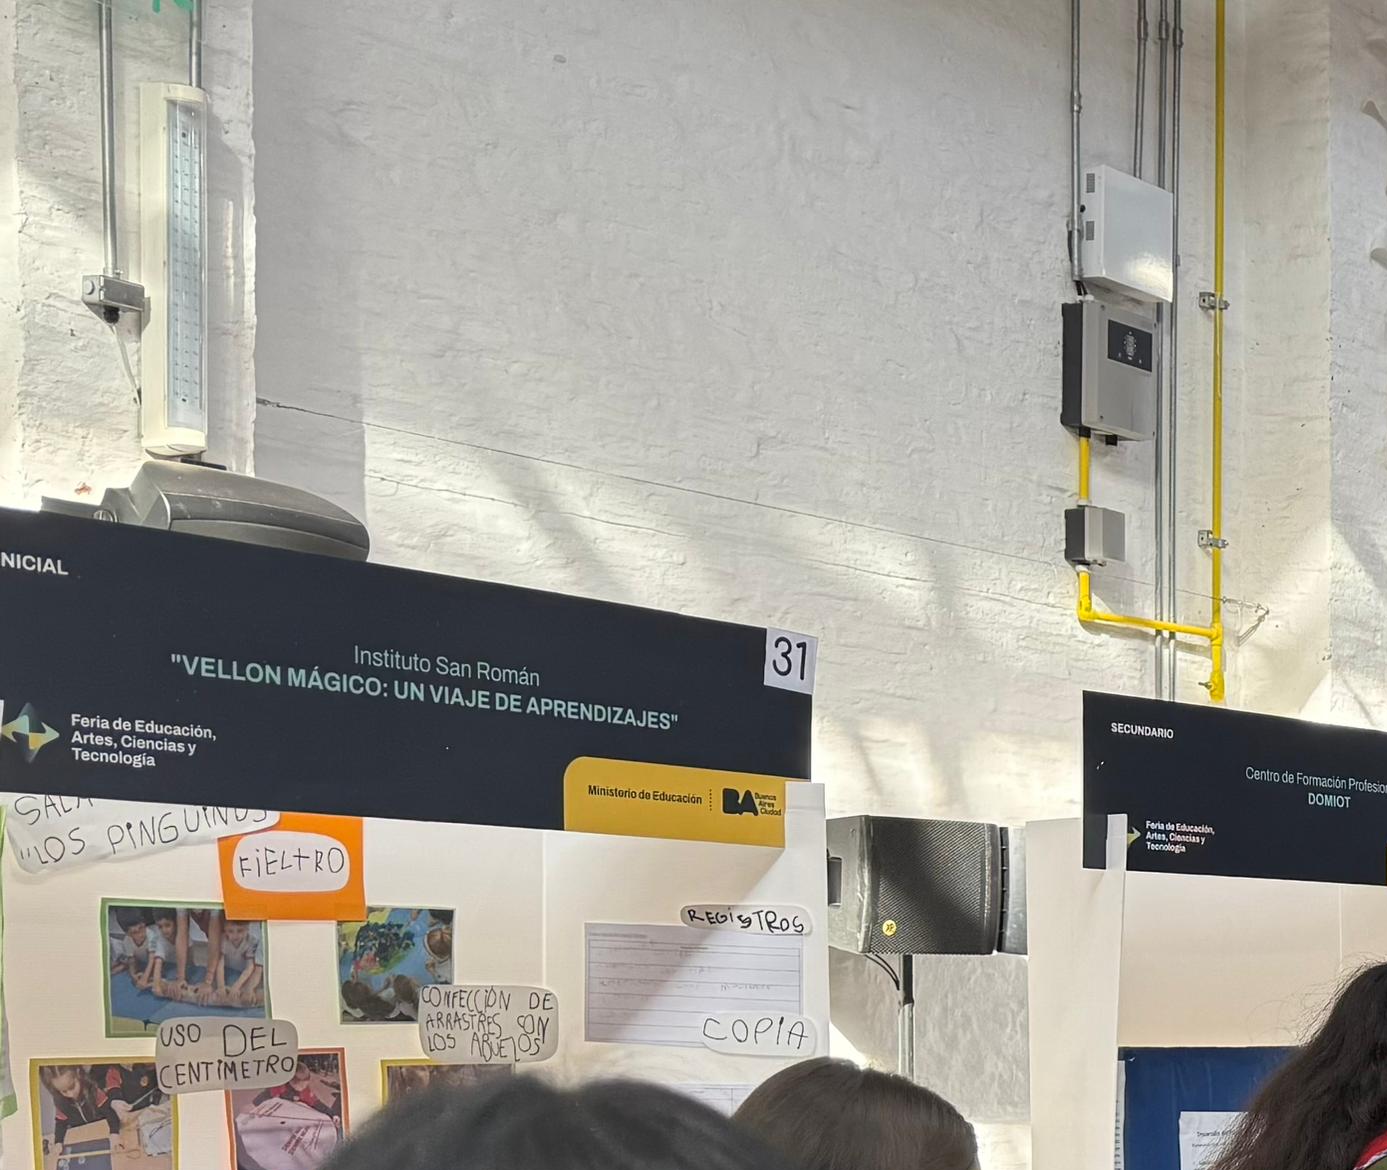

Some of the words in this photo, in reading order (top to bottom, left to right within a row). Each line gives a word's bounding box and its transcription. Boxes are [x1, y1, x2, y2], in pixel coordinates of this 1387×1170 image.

[354, 645, 431, 673] Instituto
[435, 656, 471, 678] San
[477, 661, 540, 687] Román
[772, 636, 807, 680] 31
[171, 653, 281, 685] "VELLON
[287, 665, 388, 697] MÁGICO:
[393, 680, 425, 702] UN
[429, 684, 490, 709] VIAJE
[495, 692, 522, 713] DE
[526, 697, 679, 730] APRENDIZAJES"
[71, 713, 110, 730] Feria
[112, 717, 131, 732] de
[135, 719, 217, 741] Educación,
[1110, 722, 1174, 739] SECUNDARIO
[71, 731, 118, 749] Artes,
[121, 735, 185, 753] Ciencias
[187, 742, 197, 756] y
[71, 747, 156, 768] Tecnología
[1245, 766, 1280, 783] Centro
[1282, 770, 1295, 784] de
[1297, 772, 1347, 790] Formación
[588, 784, 637, 800] Ministerio
[638, 789, 651, 801] de
[652, 790, 703, 805] Educación
[722, 787, 759, 816] BA
[1308, 792, 1351, 808] DOMIOT
[1145, 820, 1164, 830] Feria
[1165, 821, 1175, 831] de
[529, 992, 554, 1010] DE
[426, 1011, 502, 1039] ARRASTRES
[703, 1016, 808, 1049] COPIA
[160, 1023, 202, 1047] USO
[222, 1024, 287, 1057] DEL
[428, 1033, 456, 1052] LOS
[471, 1032, 541, 1062] ABUELOS
